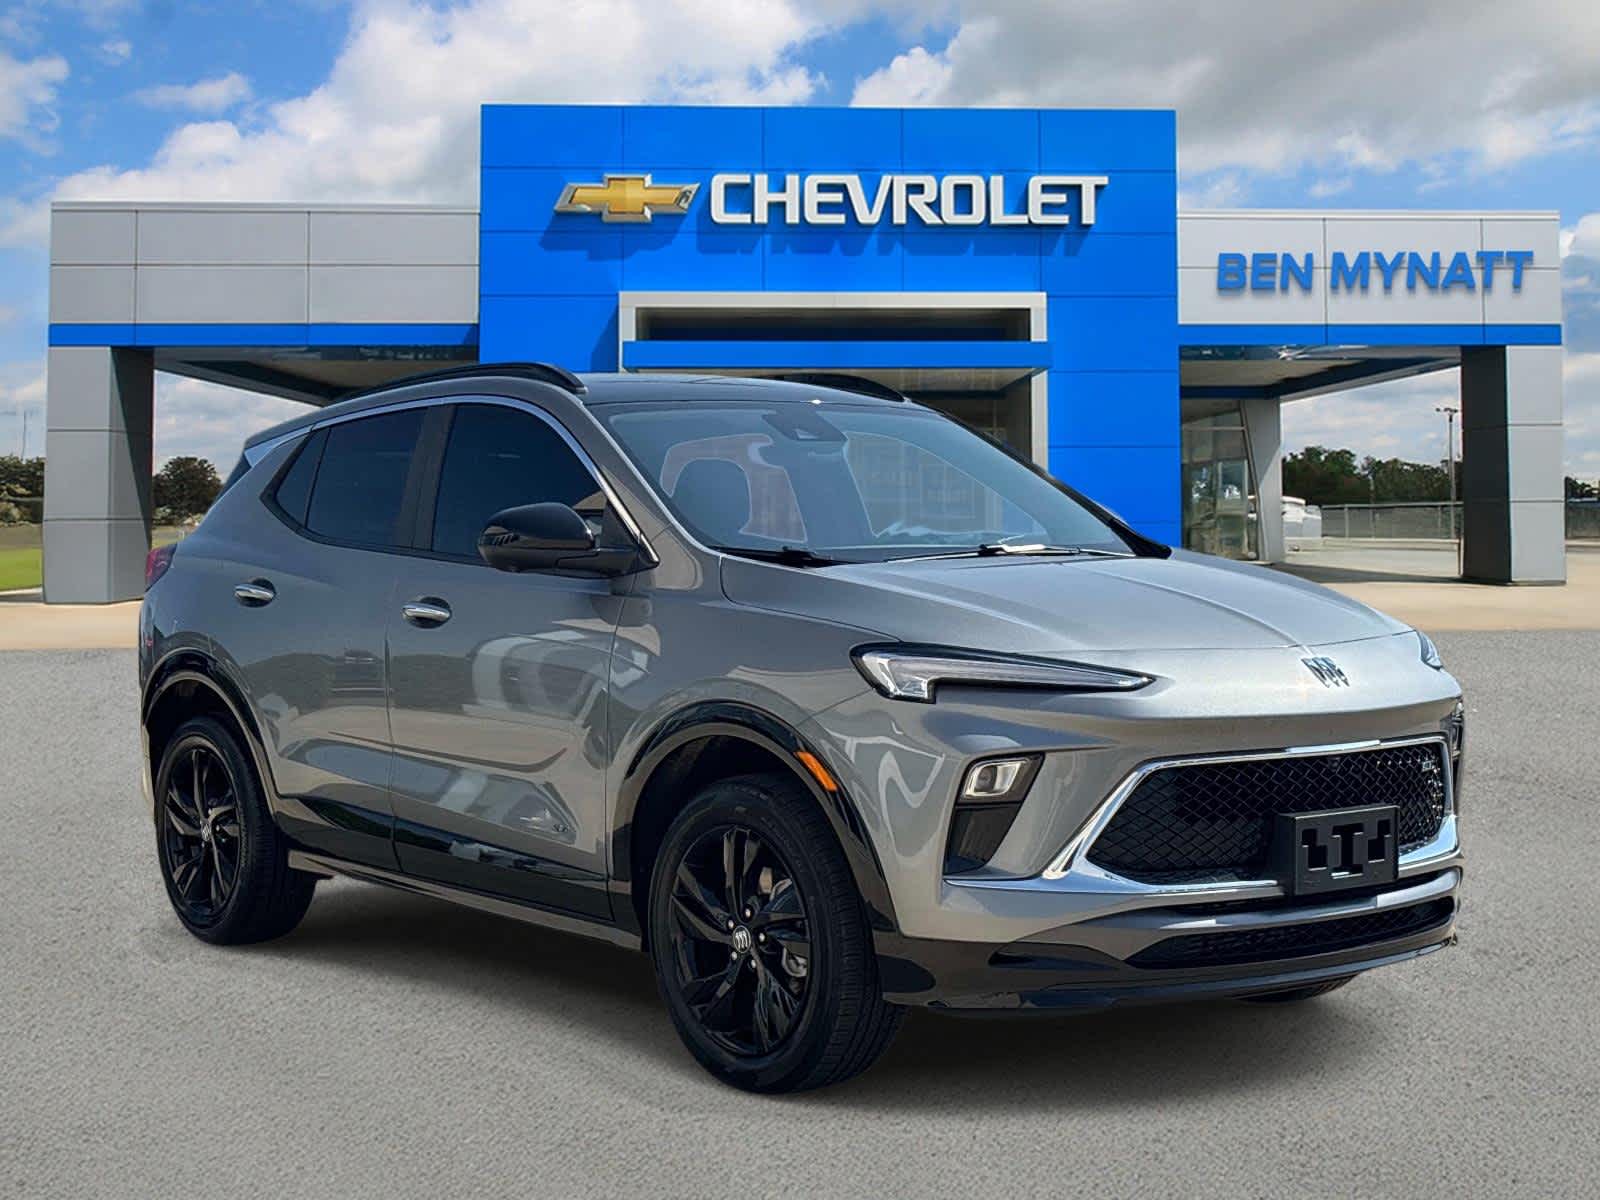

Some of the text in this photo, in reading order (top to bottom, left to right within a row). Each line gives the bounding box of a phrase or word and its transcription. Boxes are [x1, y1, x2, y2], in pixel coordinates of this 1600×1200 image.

[709, 174, 1109, 225] CHEVROLET
[1217, 250, 1534, 291] BEN MYNATT
